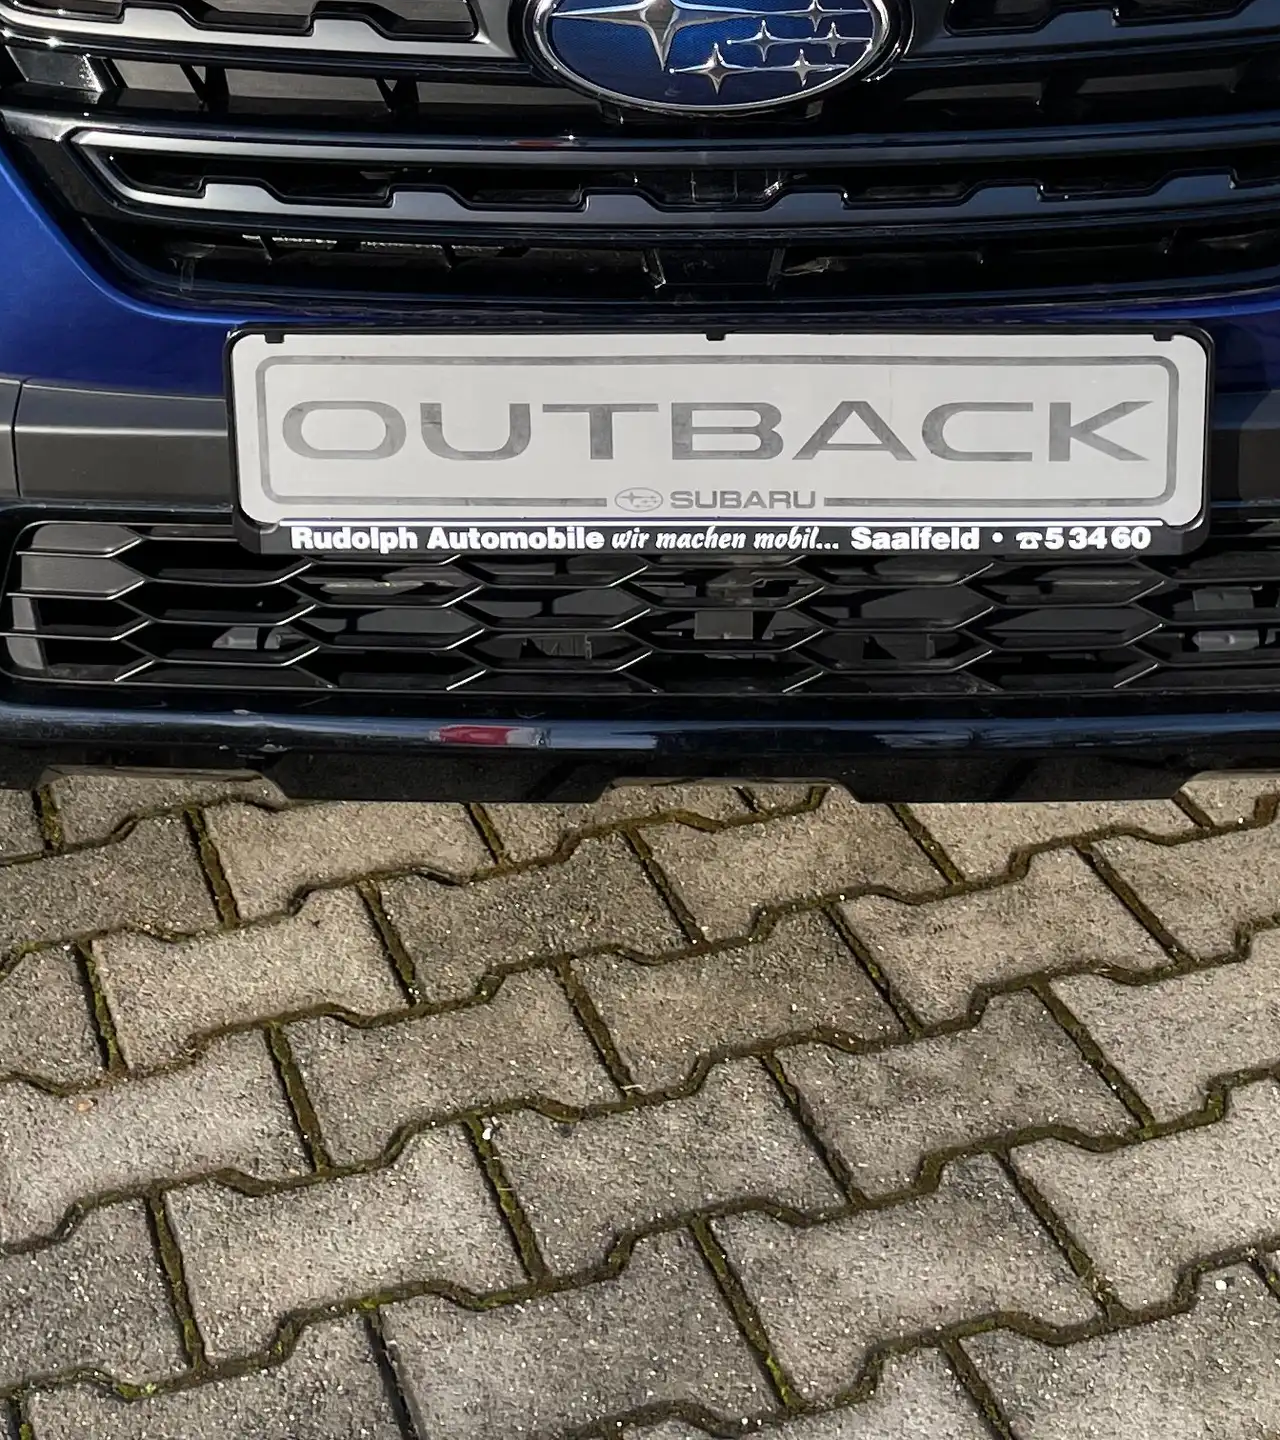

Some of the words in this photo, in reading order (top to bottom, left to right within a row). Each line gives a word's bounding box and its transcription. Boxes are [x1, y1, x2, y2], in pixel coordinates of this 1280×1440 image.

[282, 400, 1154, 462] OUTBACK
[670, 491, 816, 510] SUBARU
[291, 526, 418, 554] Rudolph
[427, 526, 604, 550] Automobile
[611, 529, 648, 550] wir
[655, 526, 746, 551] machen
[753, 526, 839, 551] mobil...
[850, 527, 980, 550] Saalfeld
